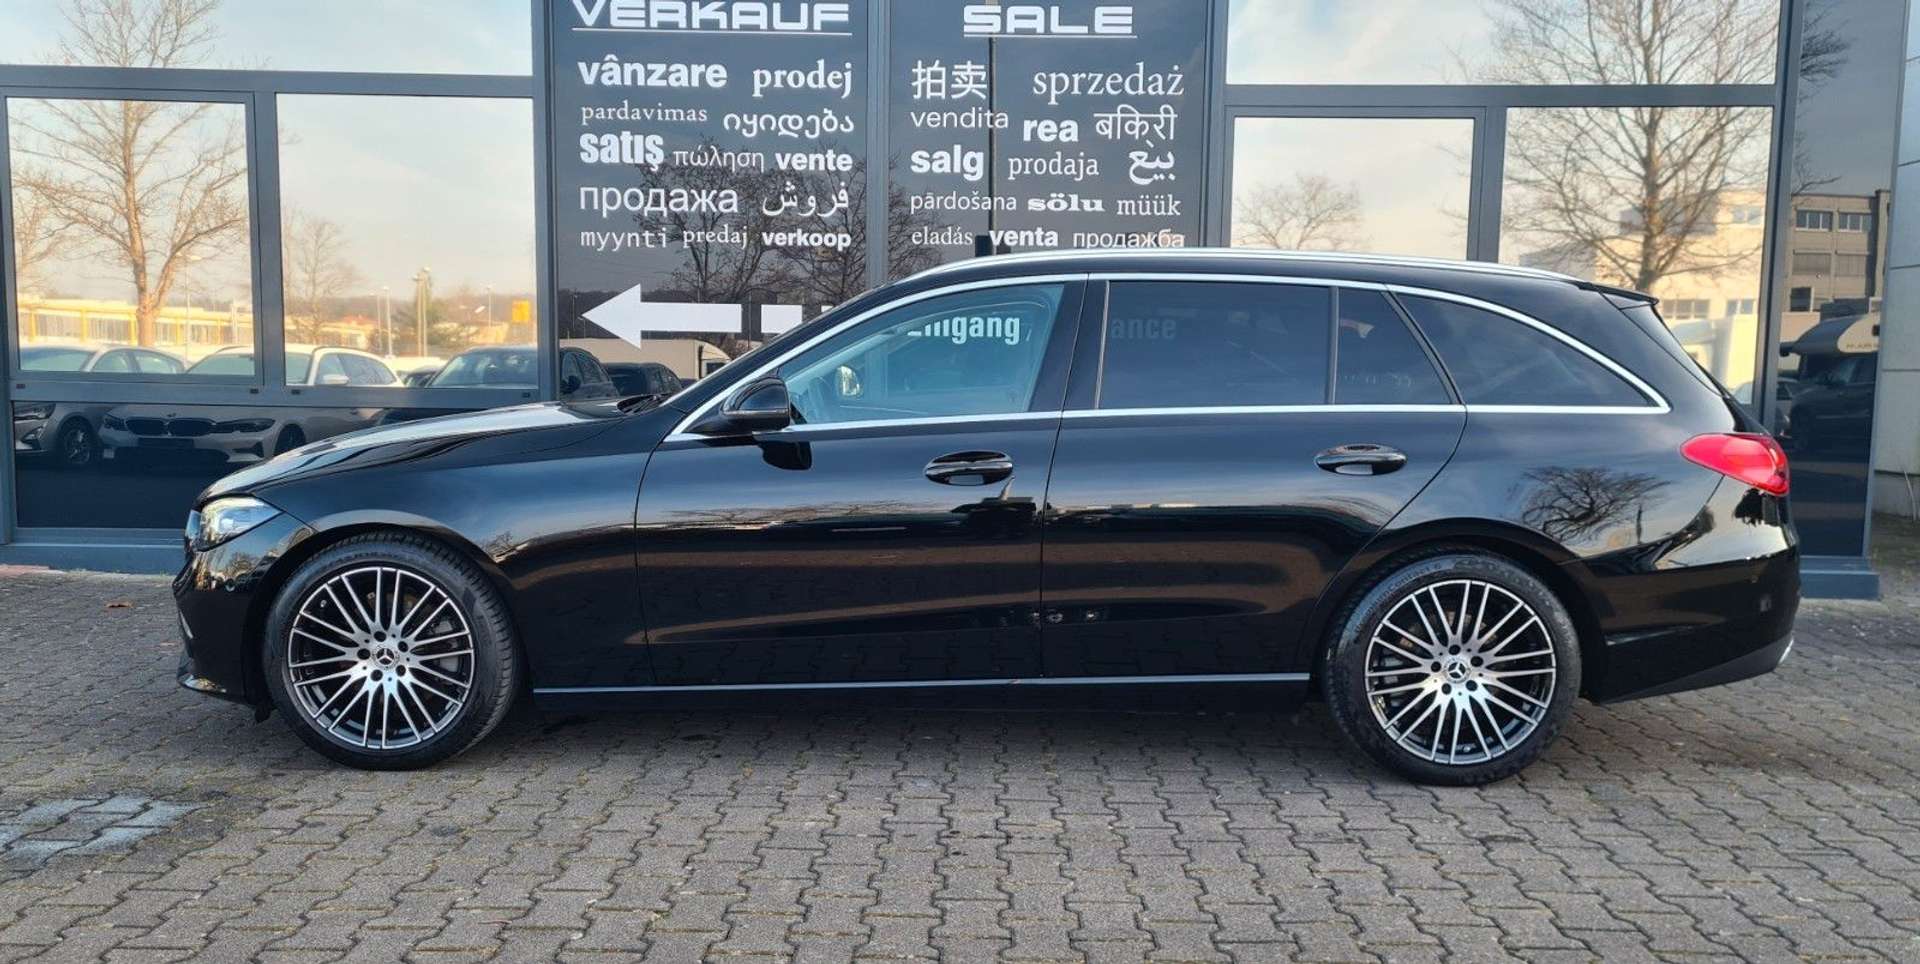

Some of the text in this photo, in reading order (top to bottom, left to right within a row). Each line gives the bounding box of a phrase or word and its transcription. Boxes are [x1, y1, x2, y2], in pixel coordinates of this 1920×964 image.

[572, 0, 850, 30] VERKAUF
[963, 4, 1133, 34] SALE
[577, 54, 728, 88] vânzare
[752, 58, 852, 99] prodej
[911, 59, 988, 100] 拍卖
[1033, 61, 1185, 107] sprzedaż
[581, 99, 708, 126] pardavimas
[723, 107, 855, 139] იყიდება
[910, 106, 1009, 129] vendita
[1023, 119, 1079, 143] rea
[579, 130, 665, 172] satış
[672, 144, 765, 173] πώληση
[775, 149, 853, 172] vente
[910, 144, 984, 182] salg
[1007, 151, 1100, 182] prodaja
[580, 186, 739, 219] продажа
[762, 180, 849, 218] فروش
[910, 190, 1017, 215] pārdošana
[1027, 192, 1105, 212] sölu
[1116, 194, 1181, 216] müük
[580, 227, 667, 252] myynti
[682, 223, 747, 250] predaj
[762, 228, 852, 252] verkoop
[911, 226, 973, 245] eladás
[989, 227, 1059, 247] venta
[1073, 228, 1185, 249] продажба
[907, 316, 1020, 345] ngang
[1111, 317, 1177, 340] ance
